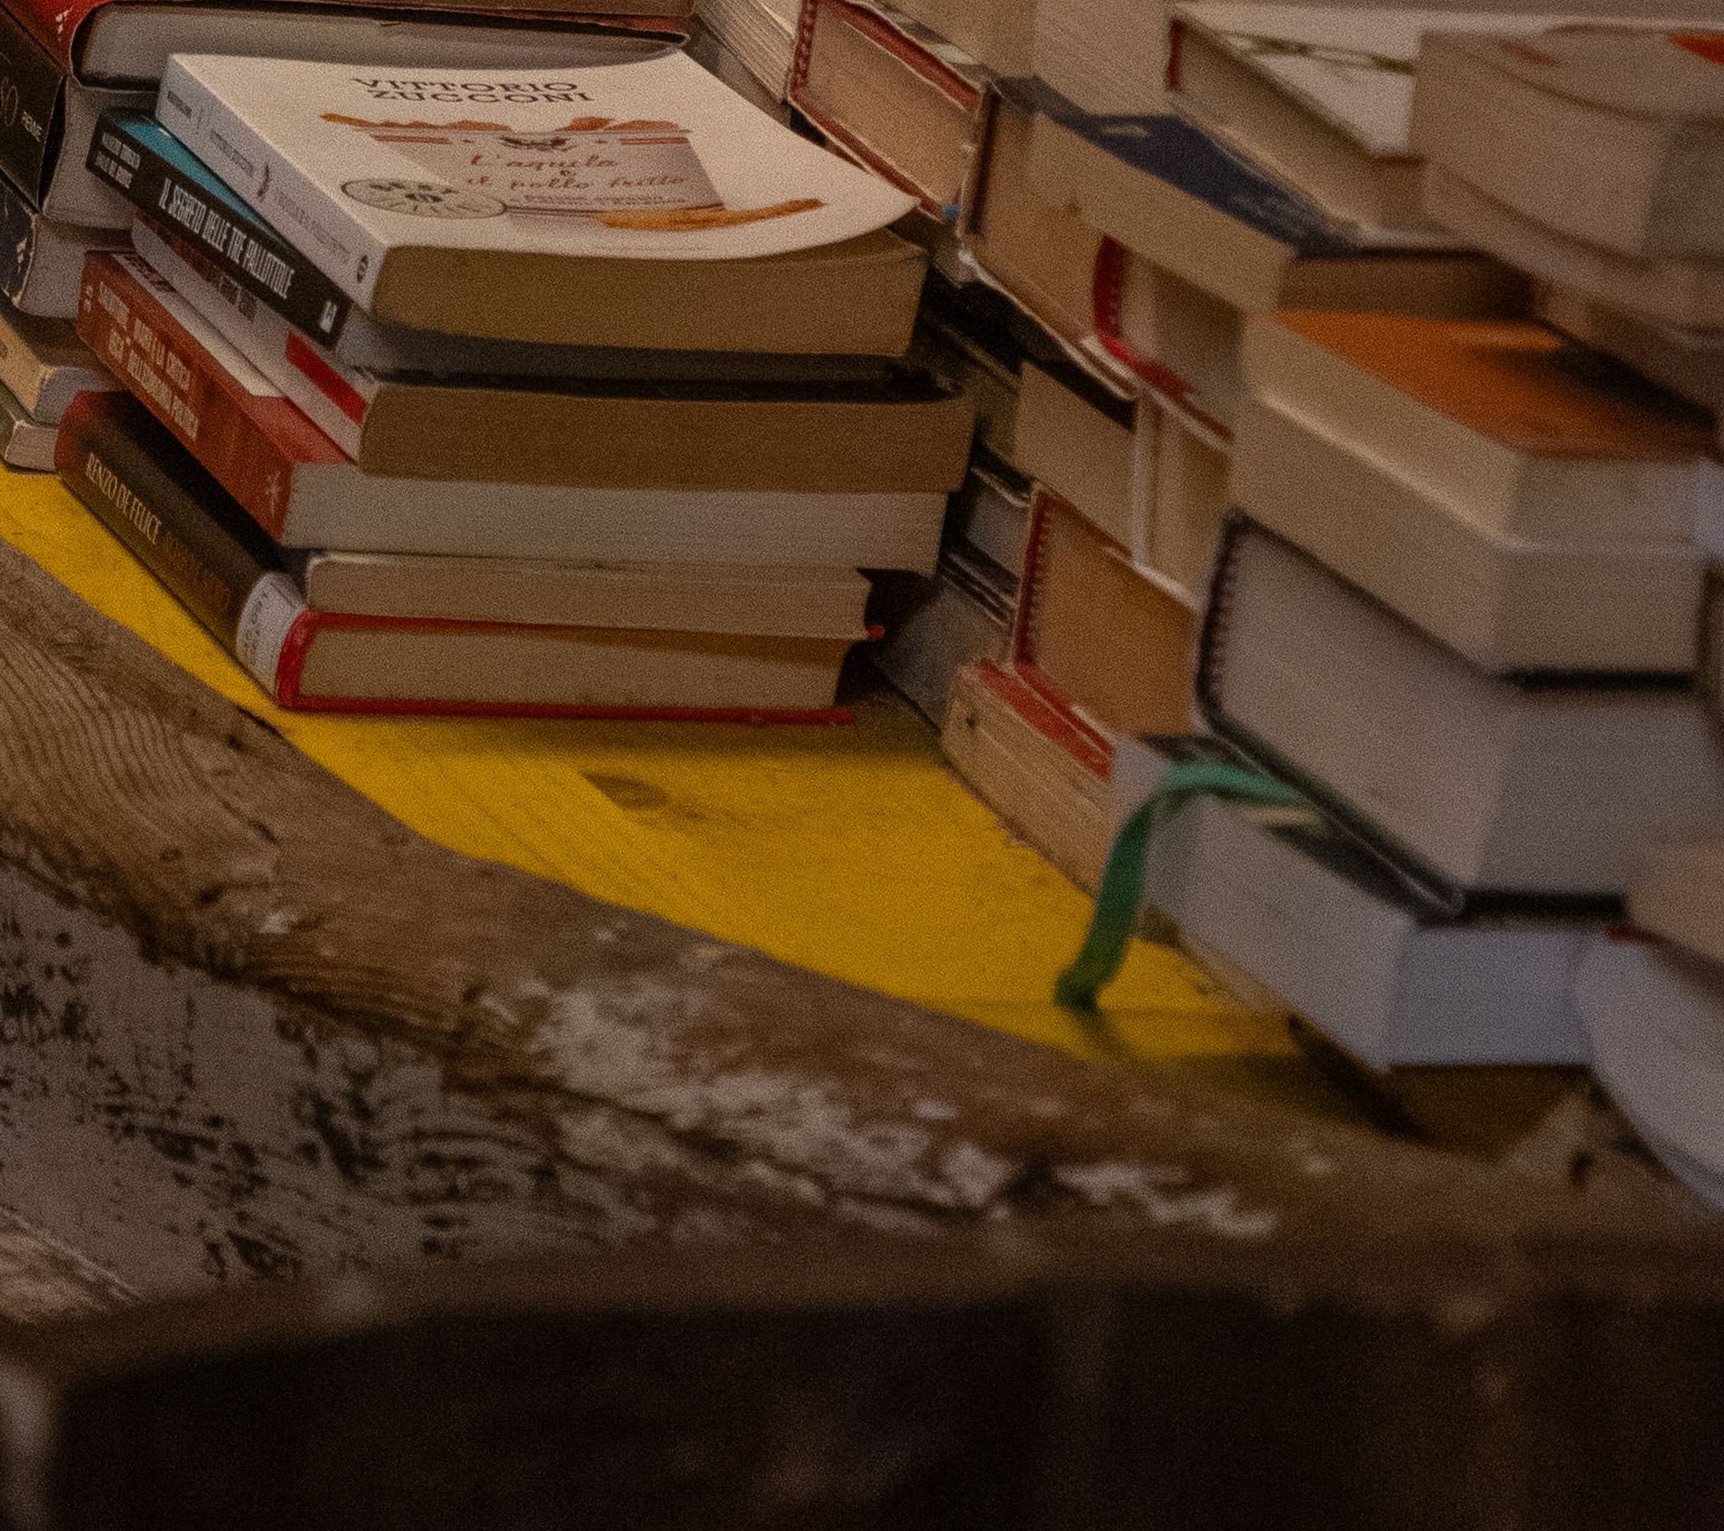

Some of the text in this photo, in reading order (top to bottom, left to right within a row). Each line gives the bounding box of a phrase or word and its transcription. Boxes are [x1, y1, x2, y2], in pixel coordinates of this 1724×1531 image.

[351, 77, 580, 94] VITTORIO
[367, 89, 595, 105] ZUCCONI
[84, 450, 164, 546] RENZO DE FELICE
